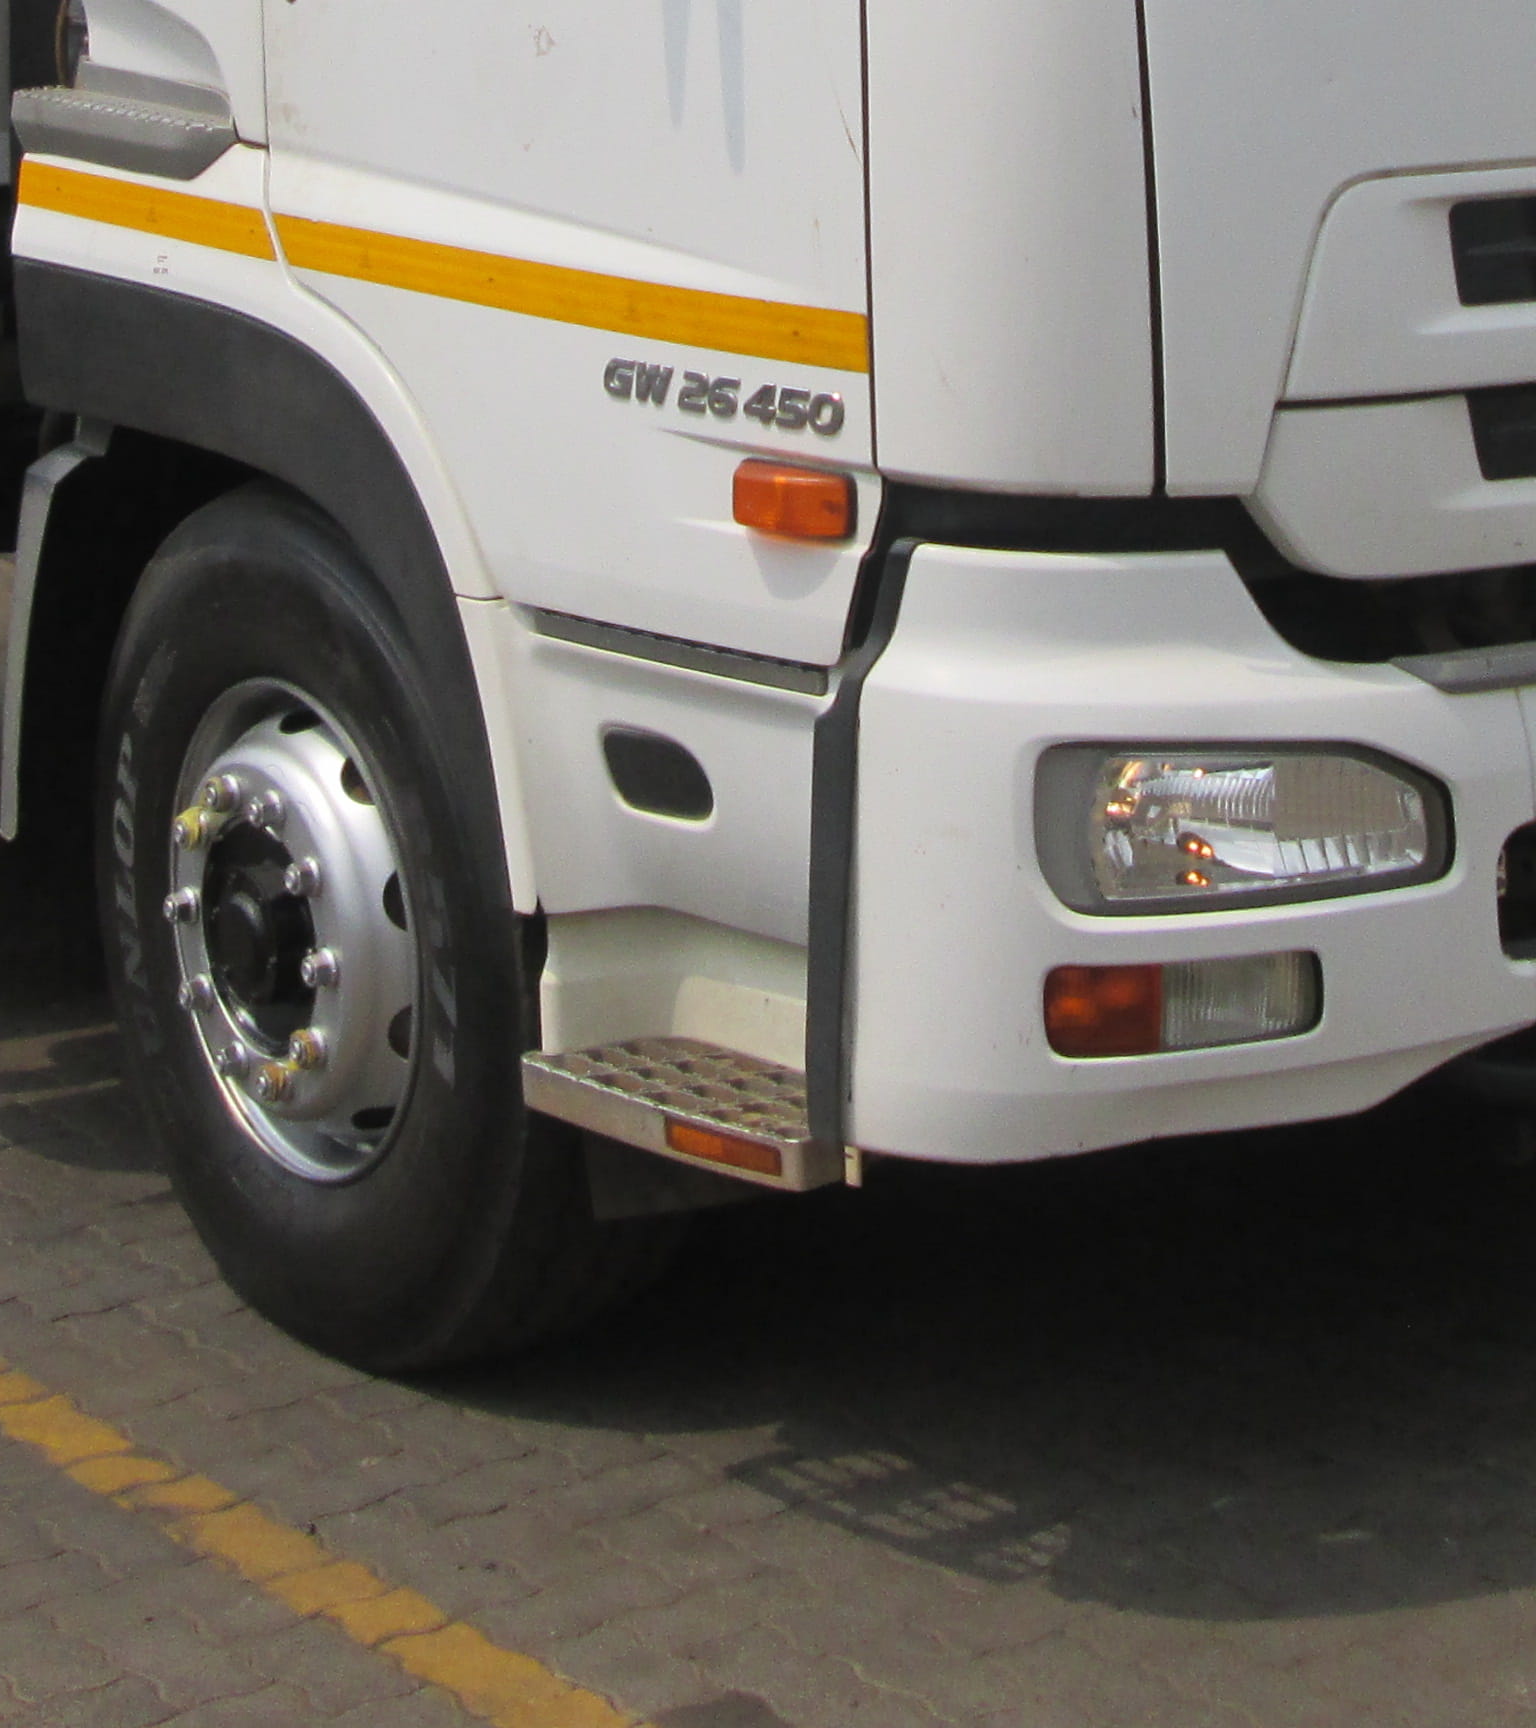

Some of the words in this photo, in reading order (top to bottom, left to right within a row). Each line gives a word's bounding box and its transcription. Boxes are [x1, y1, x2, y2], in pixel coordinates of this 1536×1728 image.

[603, 357, 674, 405] GW
[677, 370, 742, 418] 26
[743, 382, 846, 436] 450
